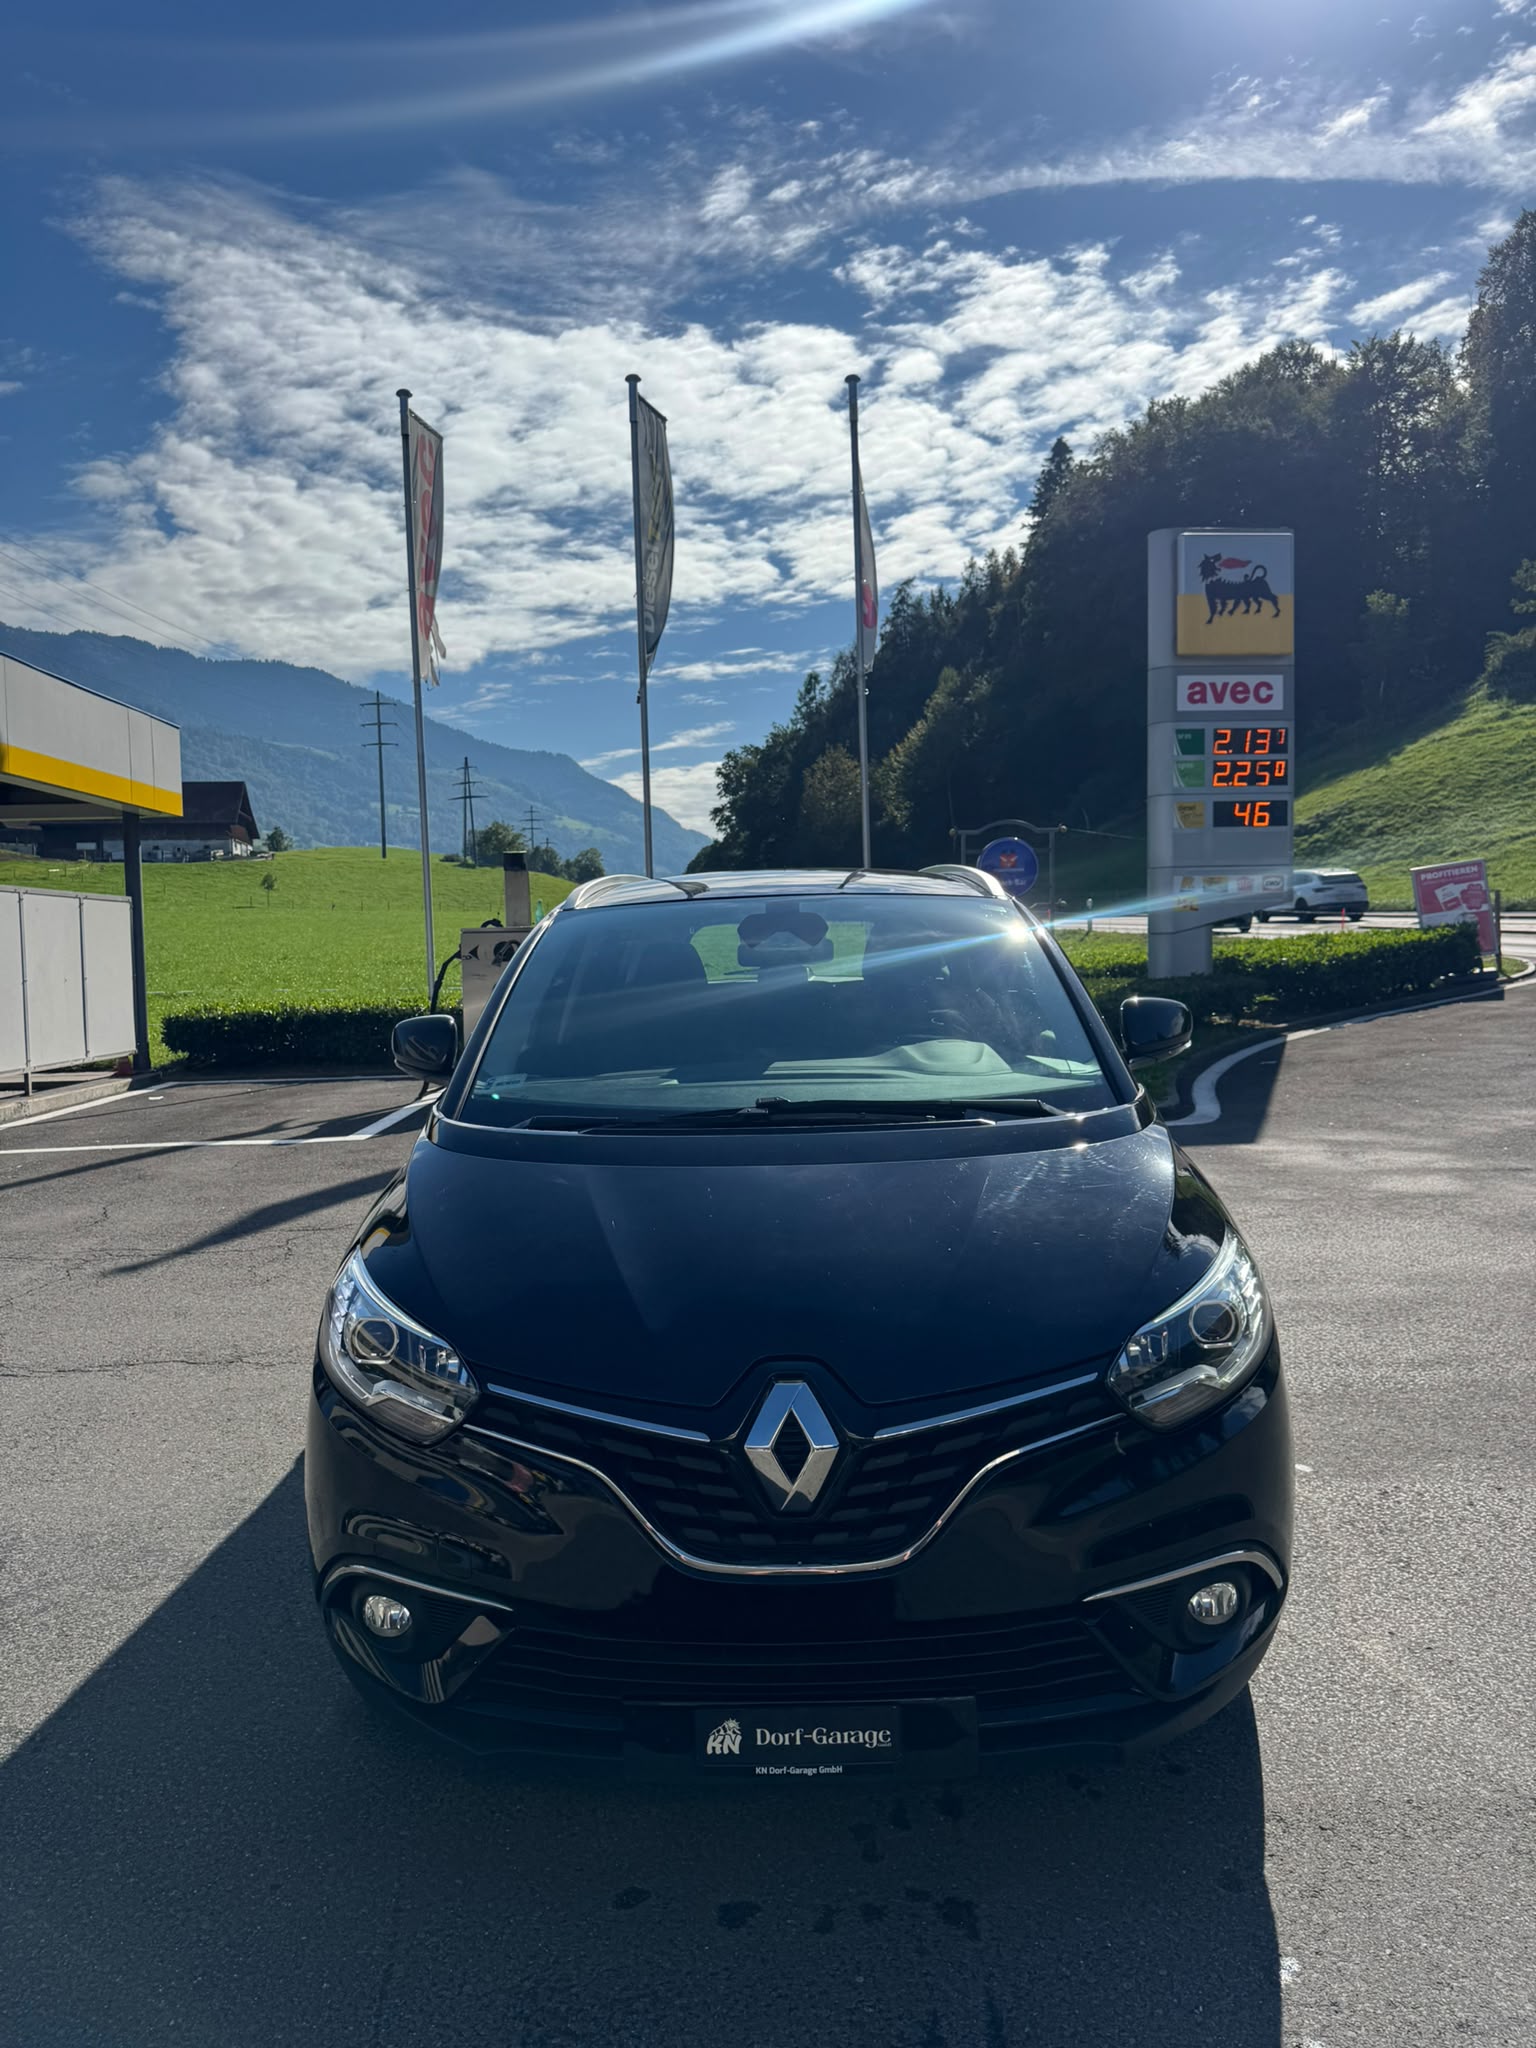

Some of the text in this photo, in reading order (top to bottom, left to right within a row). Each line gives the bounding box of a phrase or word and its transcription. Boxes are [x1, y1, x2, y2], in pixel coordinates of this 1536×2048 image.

[1187, 681, 1274, 704] avec
[1233, 802, 1271, 827] 46
[1420, 865, 1478, 880] PROFITIEREN
[755, 1727, 892, 1748] Dorf-Garage
[755, 1765, 843, 1776] KN Dorf-Garage GmbH
